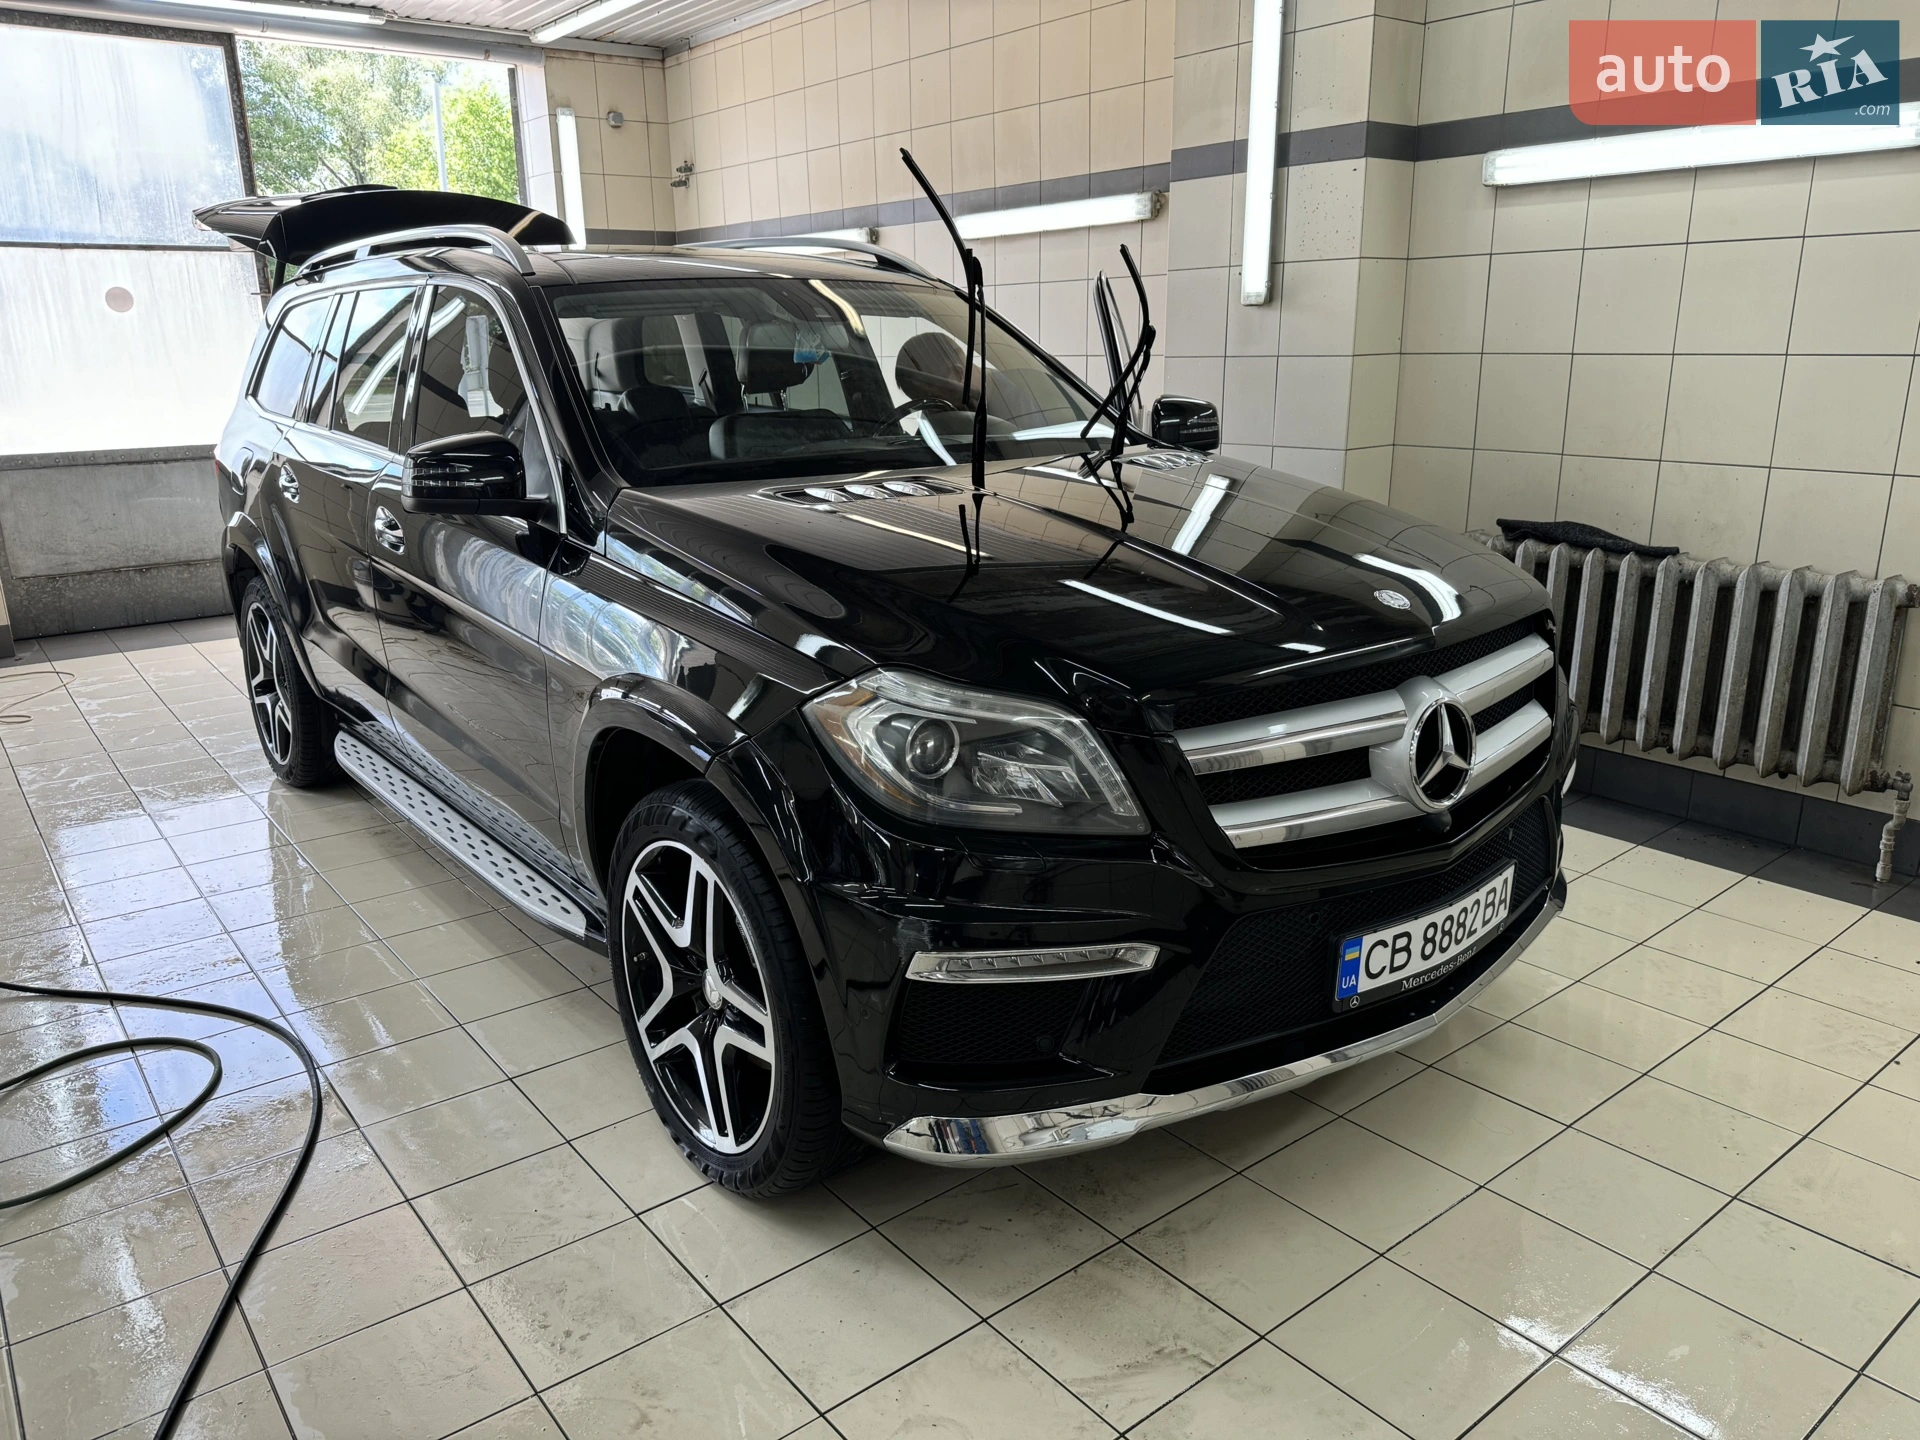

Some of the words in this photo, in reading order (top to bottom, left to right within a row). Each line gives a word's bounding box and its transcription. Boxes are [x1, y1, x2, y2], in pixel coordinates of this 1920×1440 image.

[1364, 931, 1413, 980] CB
[1401, 946, 1477, 991] Mercedes-Benz
[1341, 974, 1357, 989] UA
